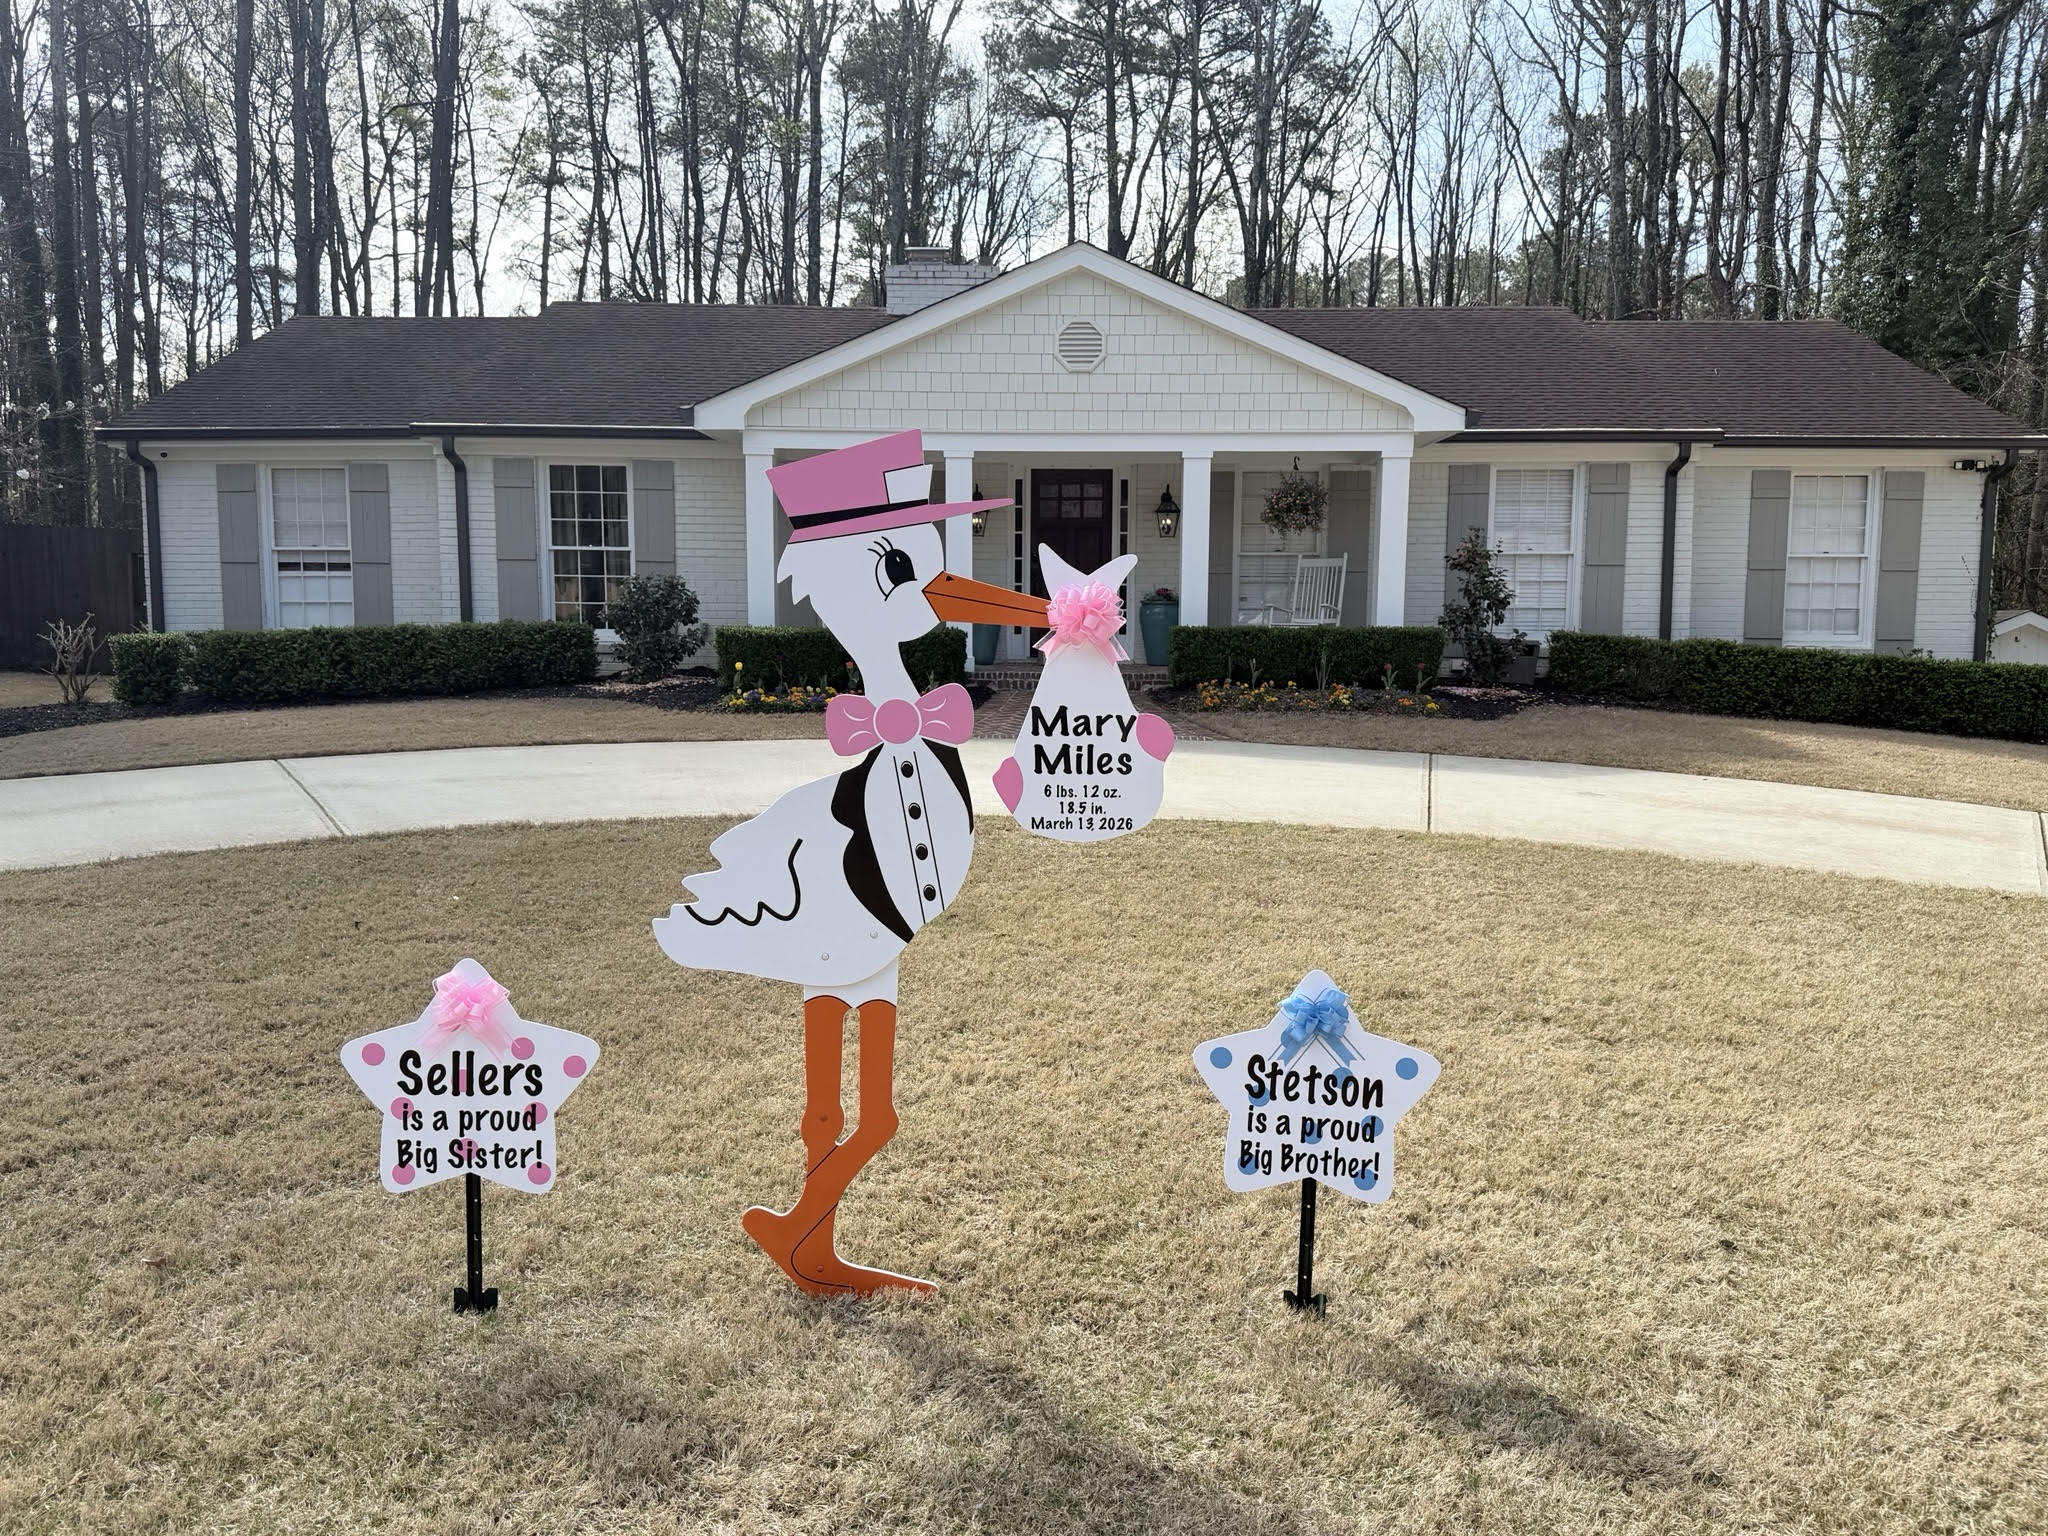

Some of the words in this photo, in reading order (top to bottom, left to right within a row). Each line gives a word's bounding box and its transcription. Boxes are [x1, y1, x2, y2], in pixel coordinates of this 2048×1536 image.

[1031, 705, 1137, 742] Mary
[1033, 743, 1133, 775] Miles
[1044, 784, 1052, 798] 6
[1056, 784, 1078, 798] lbs.
[1083, 784, 1099, 798] 12
[1103, 788, 1122, 799] oz.
[1059, 801, 1087, 815] 18.5
[1091, 801, 1107, 815] in.
[1031, 816, 1073, 830] March
[1099, 817, 1133, 830] 2026
[397, 1049, 543, 1096] Sellers
[1244, 1054, 1384, 1110] Stetson
[402, 1103, 423, 1131] is
[432, 1109, 449, 1131] a
[459, 1103, 537, 1137] proud
[1247, 1105, 1267, 1134] is
[1275, 1114, 1291, 1135] a
[1300, 1115, 1376, 1143] proud
[397, 1139, 438, 1174] Big
[447, 1138, 543, 1170] Sister!
[1239, 1139, 1273, 1176] Big
[1280, 1143, 1380, 1181] Brother!
